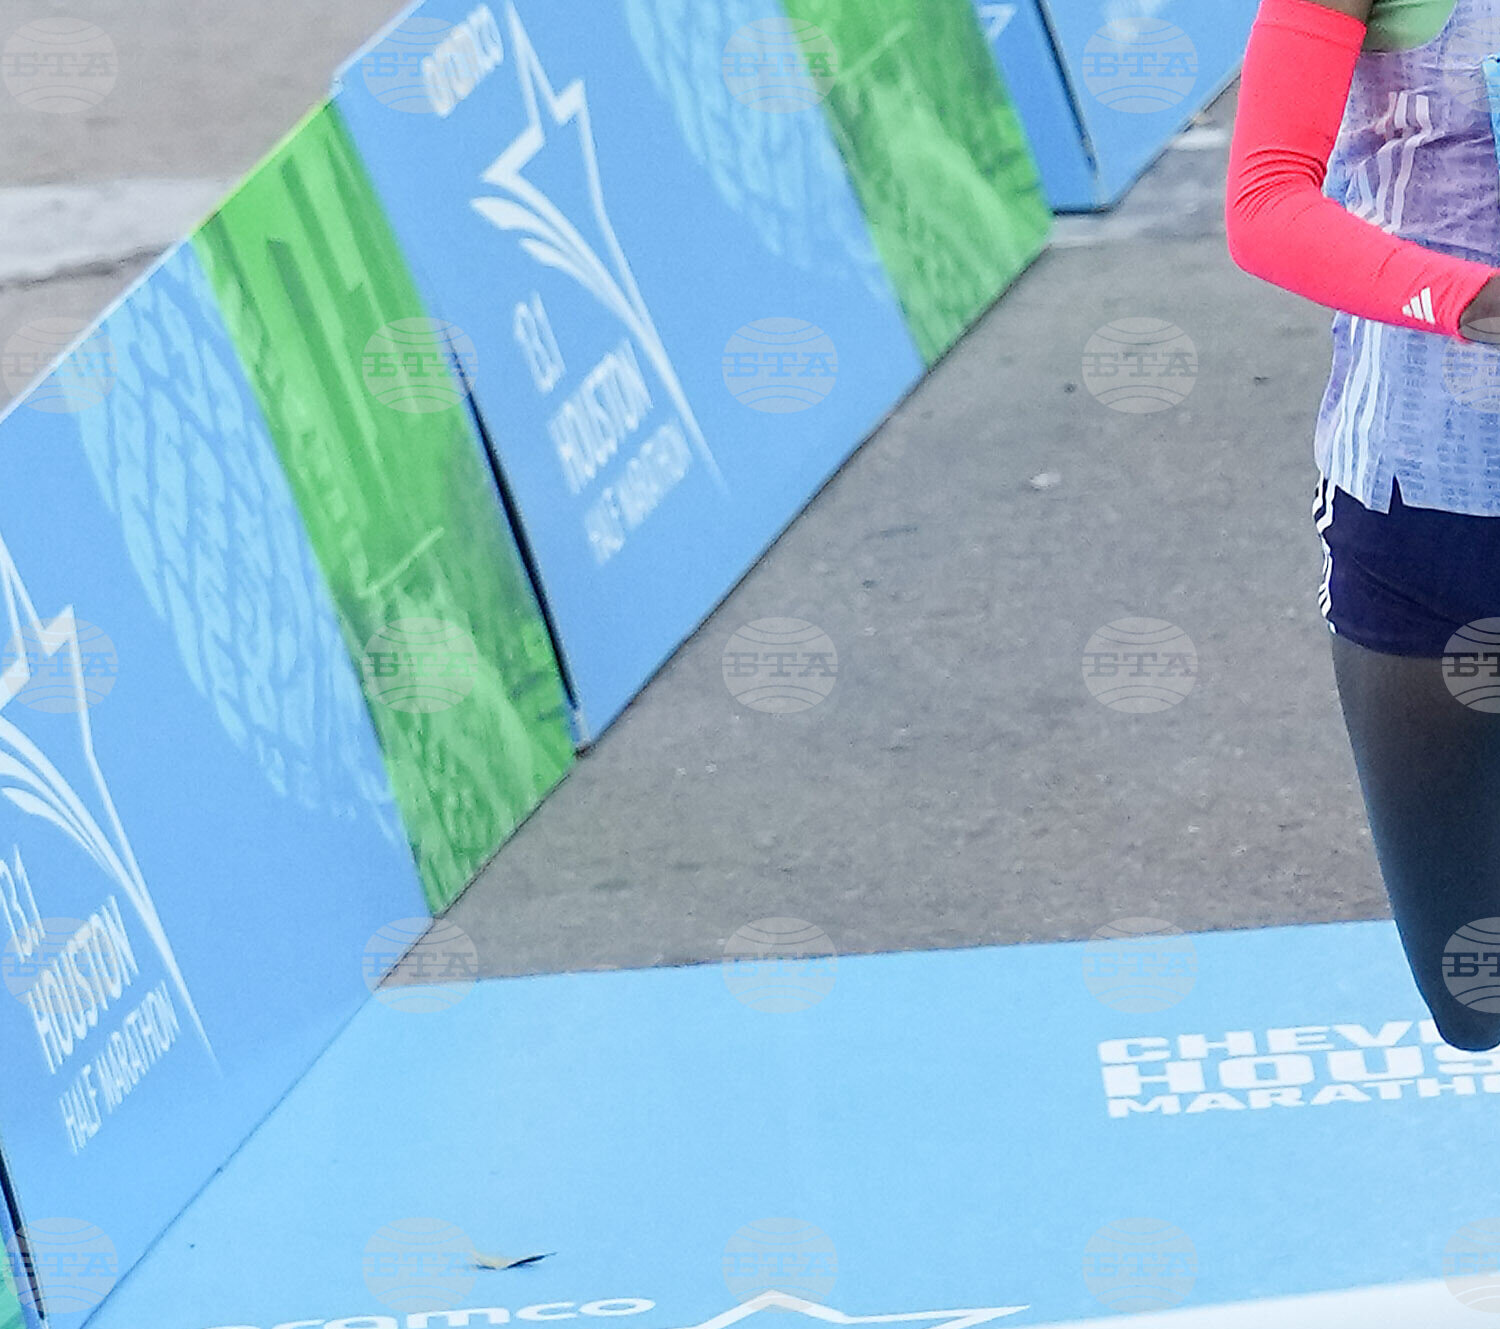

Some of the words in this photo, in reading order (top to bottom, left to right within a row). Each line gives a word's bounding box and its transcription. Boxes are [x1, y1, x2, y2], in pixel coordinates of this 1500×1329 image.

[28, 895, 139, 1074] HOUSTON
[60, 1064, 103, 1155] HALF
[97, 979, 181, 1113] MARATHON
